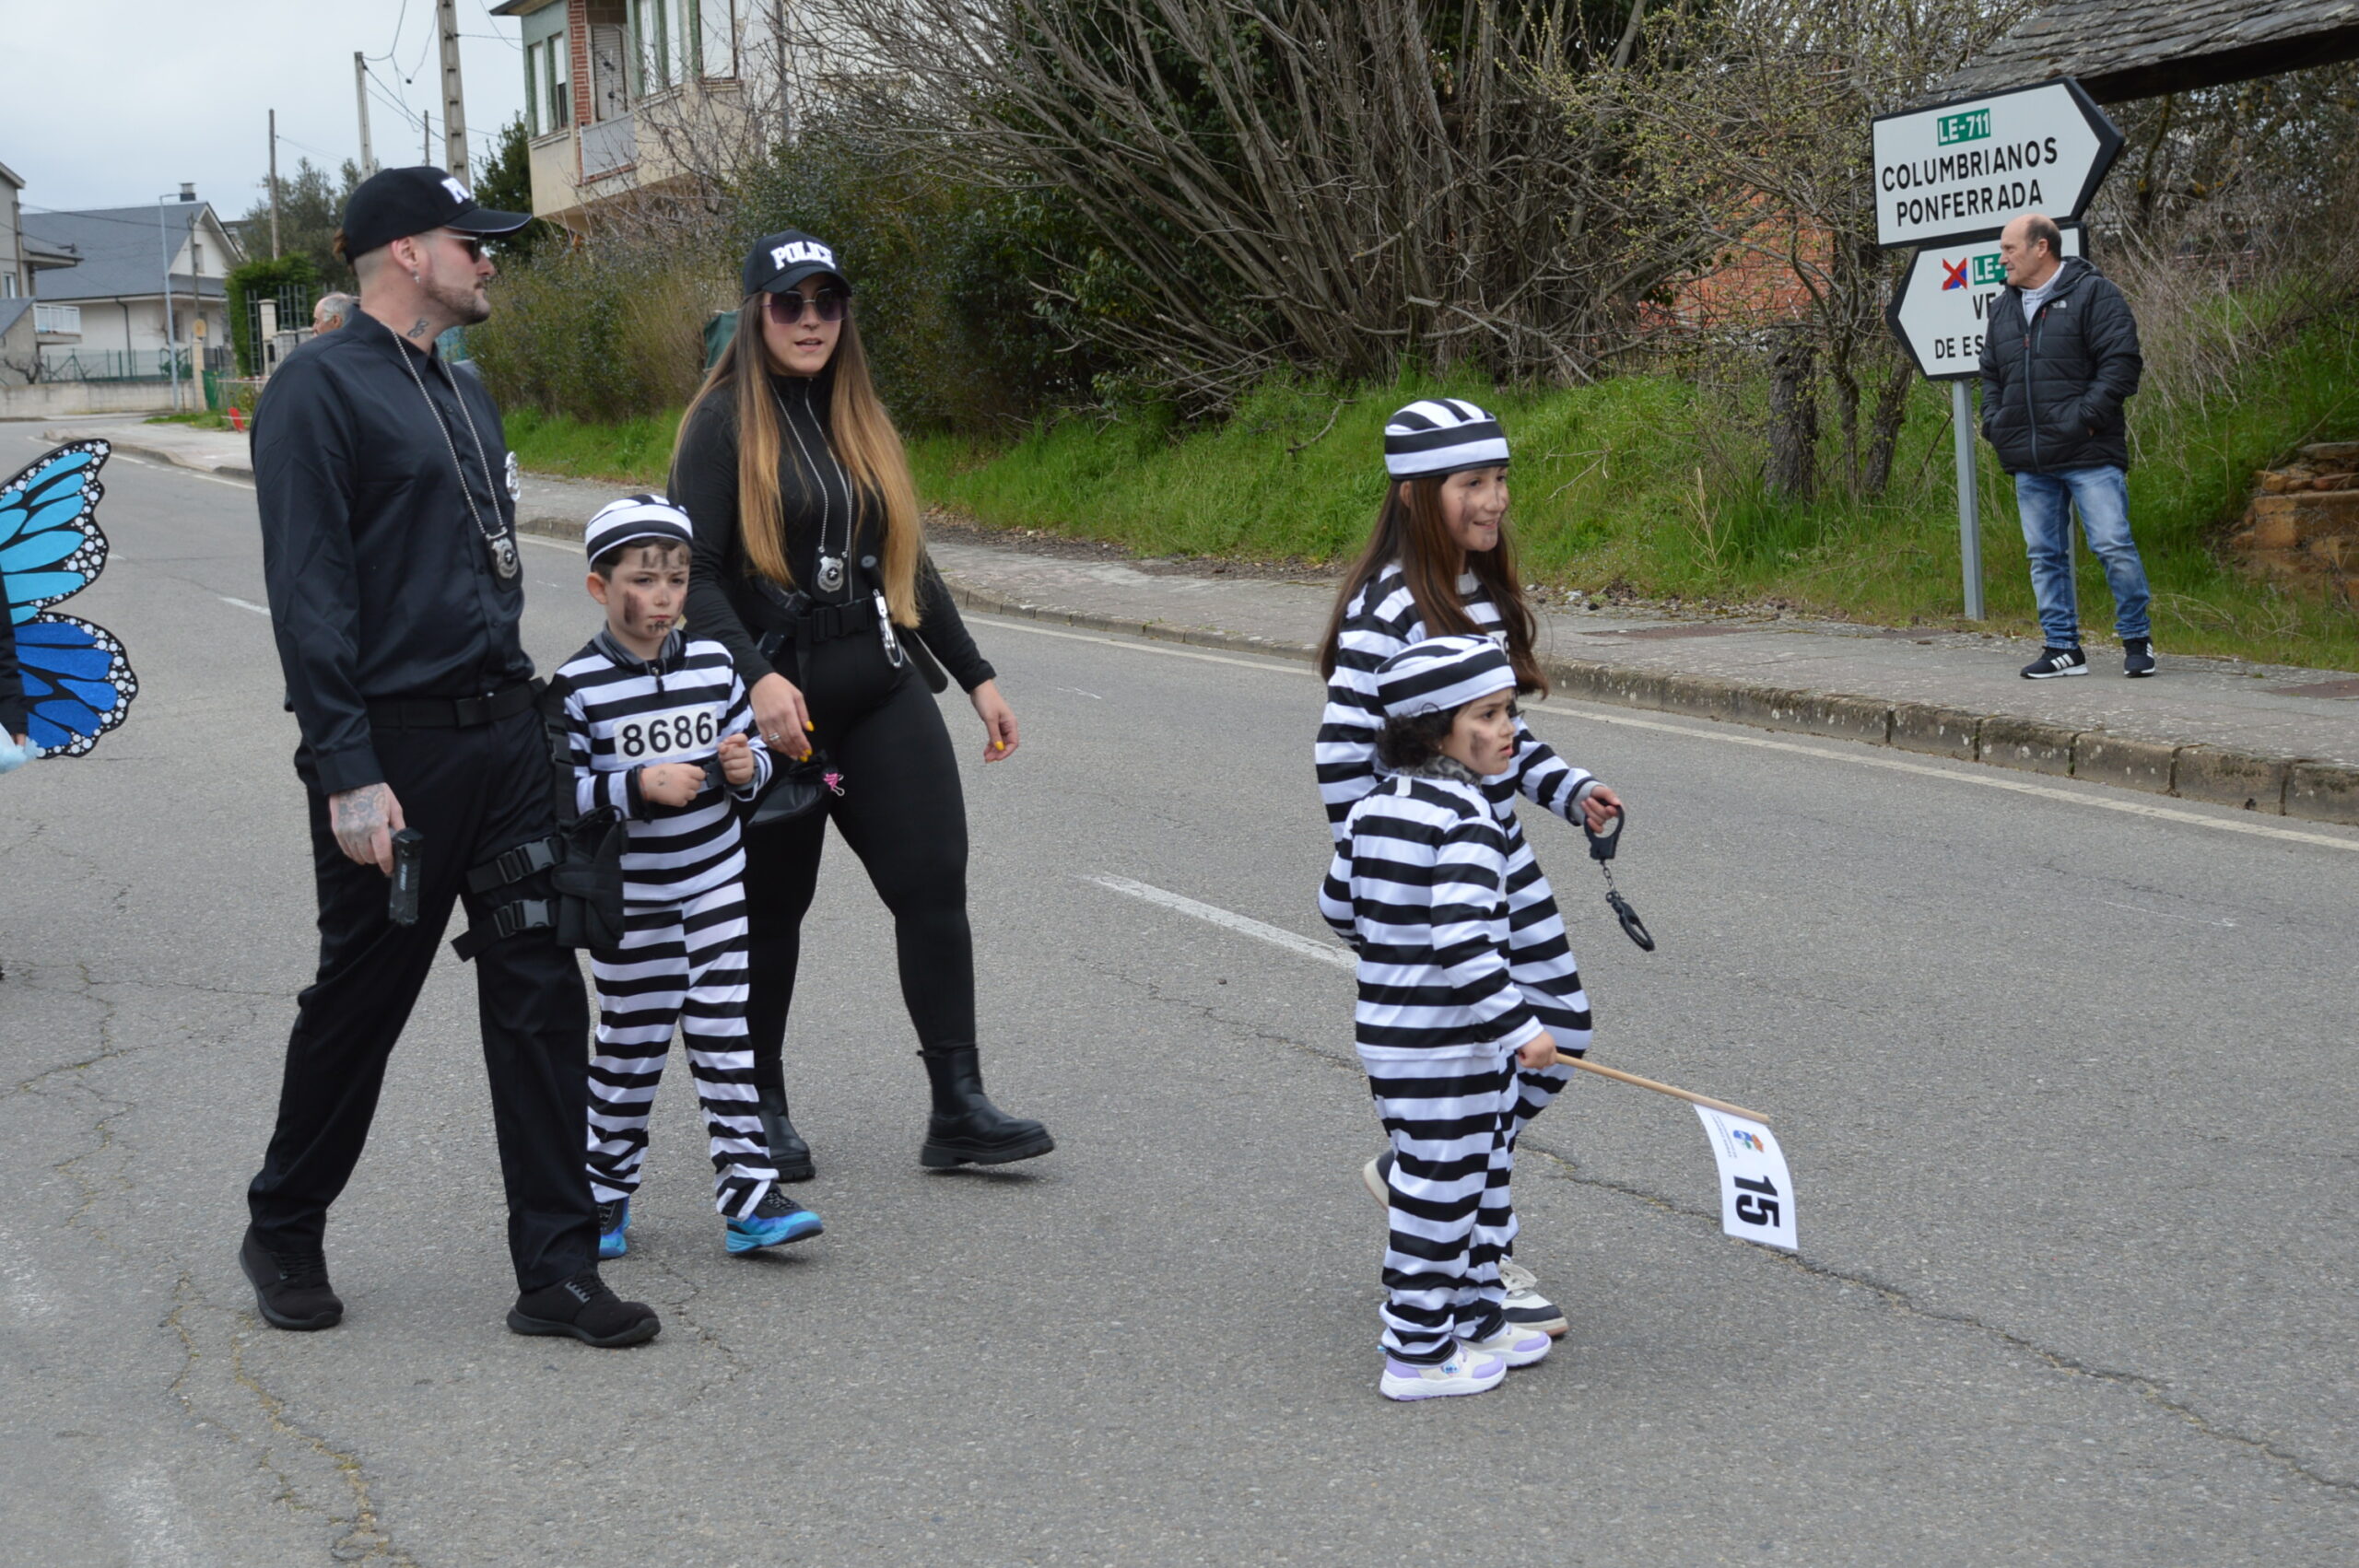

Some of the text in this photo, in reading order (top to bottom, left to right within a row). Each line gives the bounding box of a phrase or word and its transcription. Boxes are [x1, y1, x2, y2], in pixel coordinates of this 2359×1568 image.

[1939, 112, 1989, 143] LE-711
[1882, 136, 2058, 193] COLUMBRIANOS
[1896, 179, 2043, 228] PONFERRADA
[1974, 257, 2007, 282] LE-
[1973, 292, 1997, 320] VE
[1935, 334, 1985, 359] DE ES
[622, 711, 713, 757] 8686
[1733, 1175, 1780, 1228] 15
